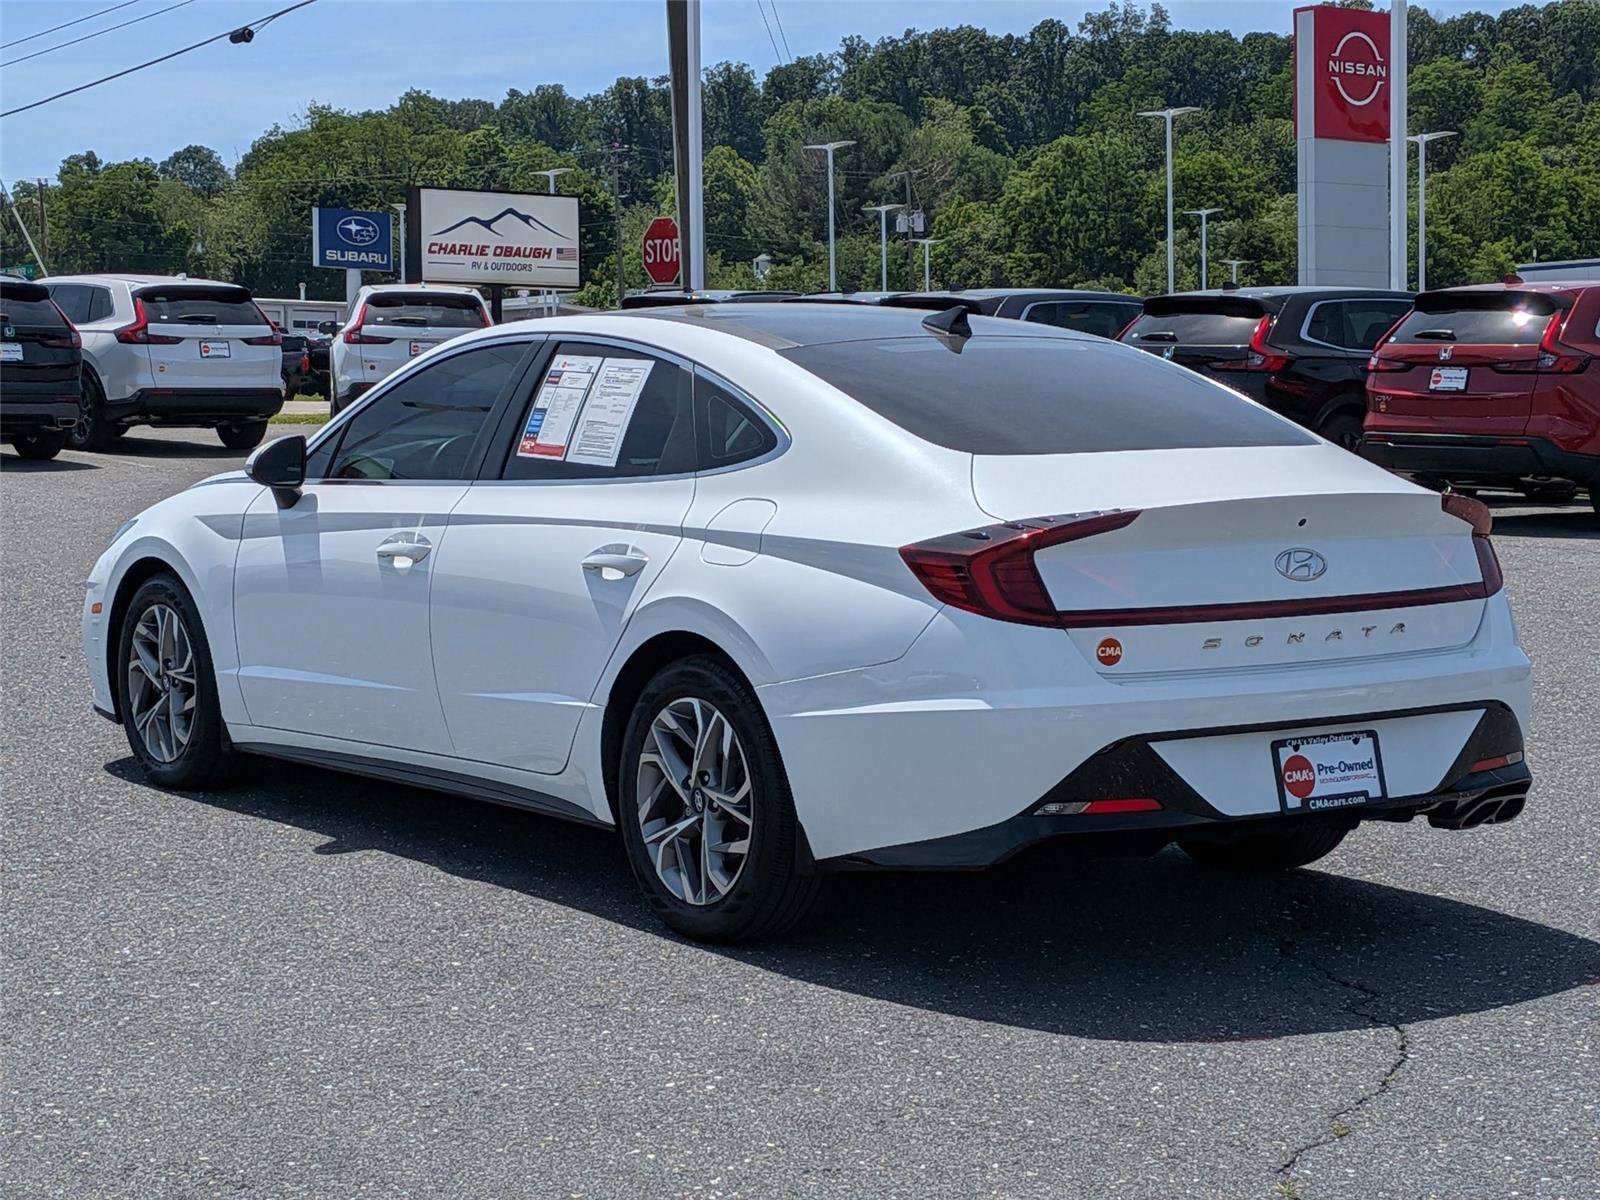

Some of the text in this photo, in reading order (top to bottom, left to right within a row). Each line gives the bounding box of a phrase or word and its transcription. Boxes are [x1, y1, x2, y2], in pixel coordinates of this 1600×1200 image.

[1328, 60, 1387, 77] NISSAN
[325, 249, 388, 264] SUBARU
[427, 242, 552, 259] CHARLIE OBAUGH
[471, 261, 533, 272] RV & OUTDOORS
[1202, 622, 1406, 649] SONATA
[1098, 646, 1122, 657] CMA
[1317, 758, 1374, 775] Pre-Owned
[1284, 769, 1314, 783] CMA's
[1310, 796, 1366, 809] CMAcars.com
